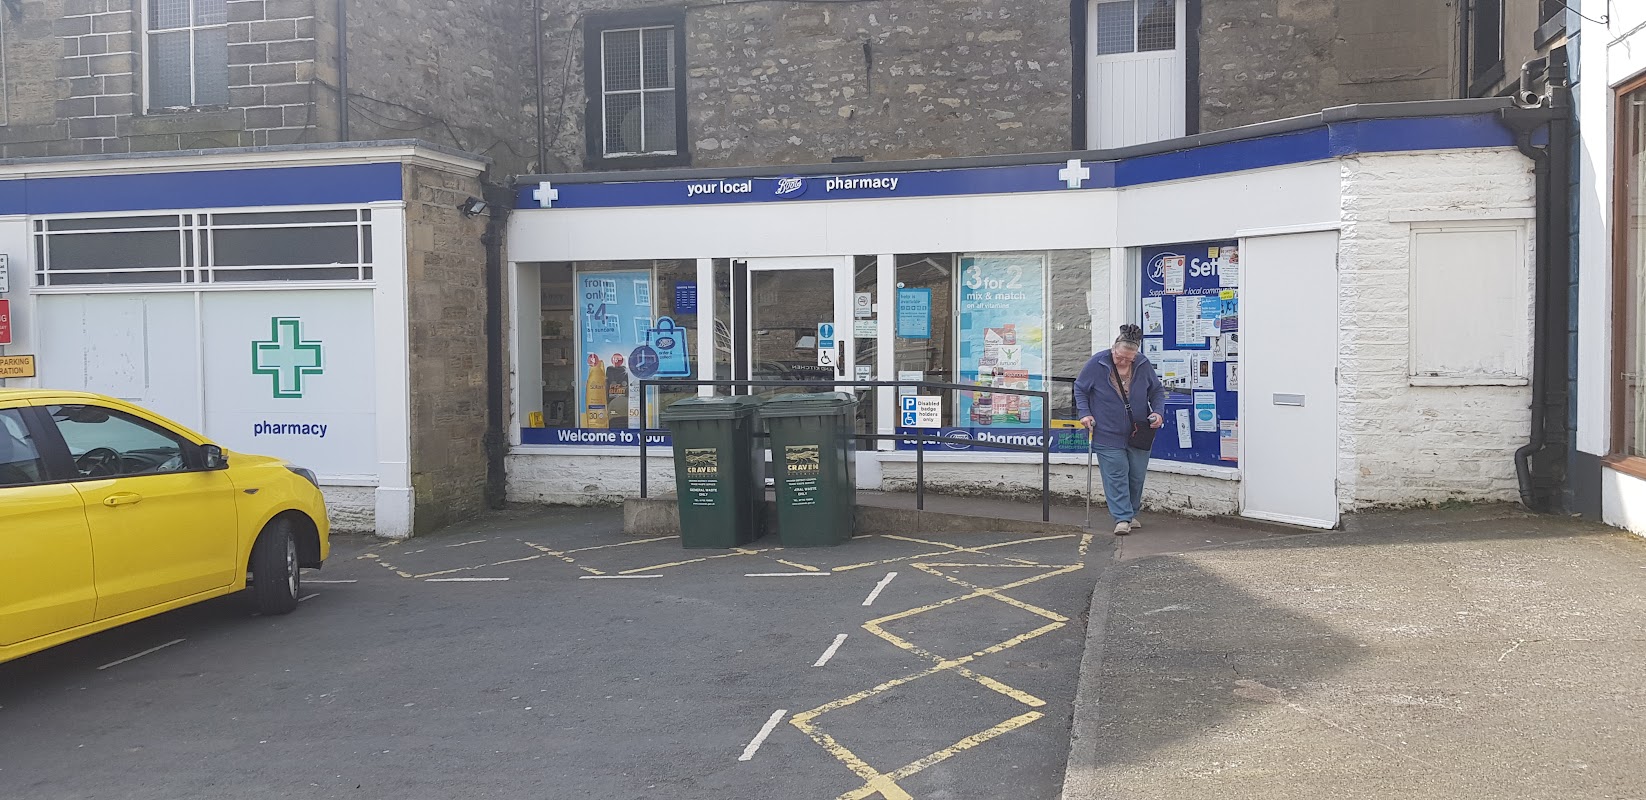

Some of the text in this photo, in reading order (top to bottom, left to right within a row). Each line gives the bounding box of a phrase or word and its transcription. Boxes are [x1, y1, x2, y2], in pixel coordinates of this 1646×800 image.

[687, 176, 898, 197] your local Boots pharmacy
[1189, 257, 1220, 277] Sett
[584, 278, 608, 288] from
[966, 264, 1023, 290] 3 for 2
[586, 290, 606, 302] only
[966, 291, 1026, 300] mix & match
[1188, 287, 1202, 295] local
[586, 303, 607, 325] £4
[0, 367, 24, 375] RATION
[906, 398, 915, 410] P
[254, 420, 328, 438] pharmacy
[557, 429, 616, 442] Welcome
[620, 430, 633, 442] to
